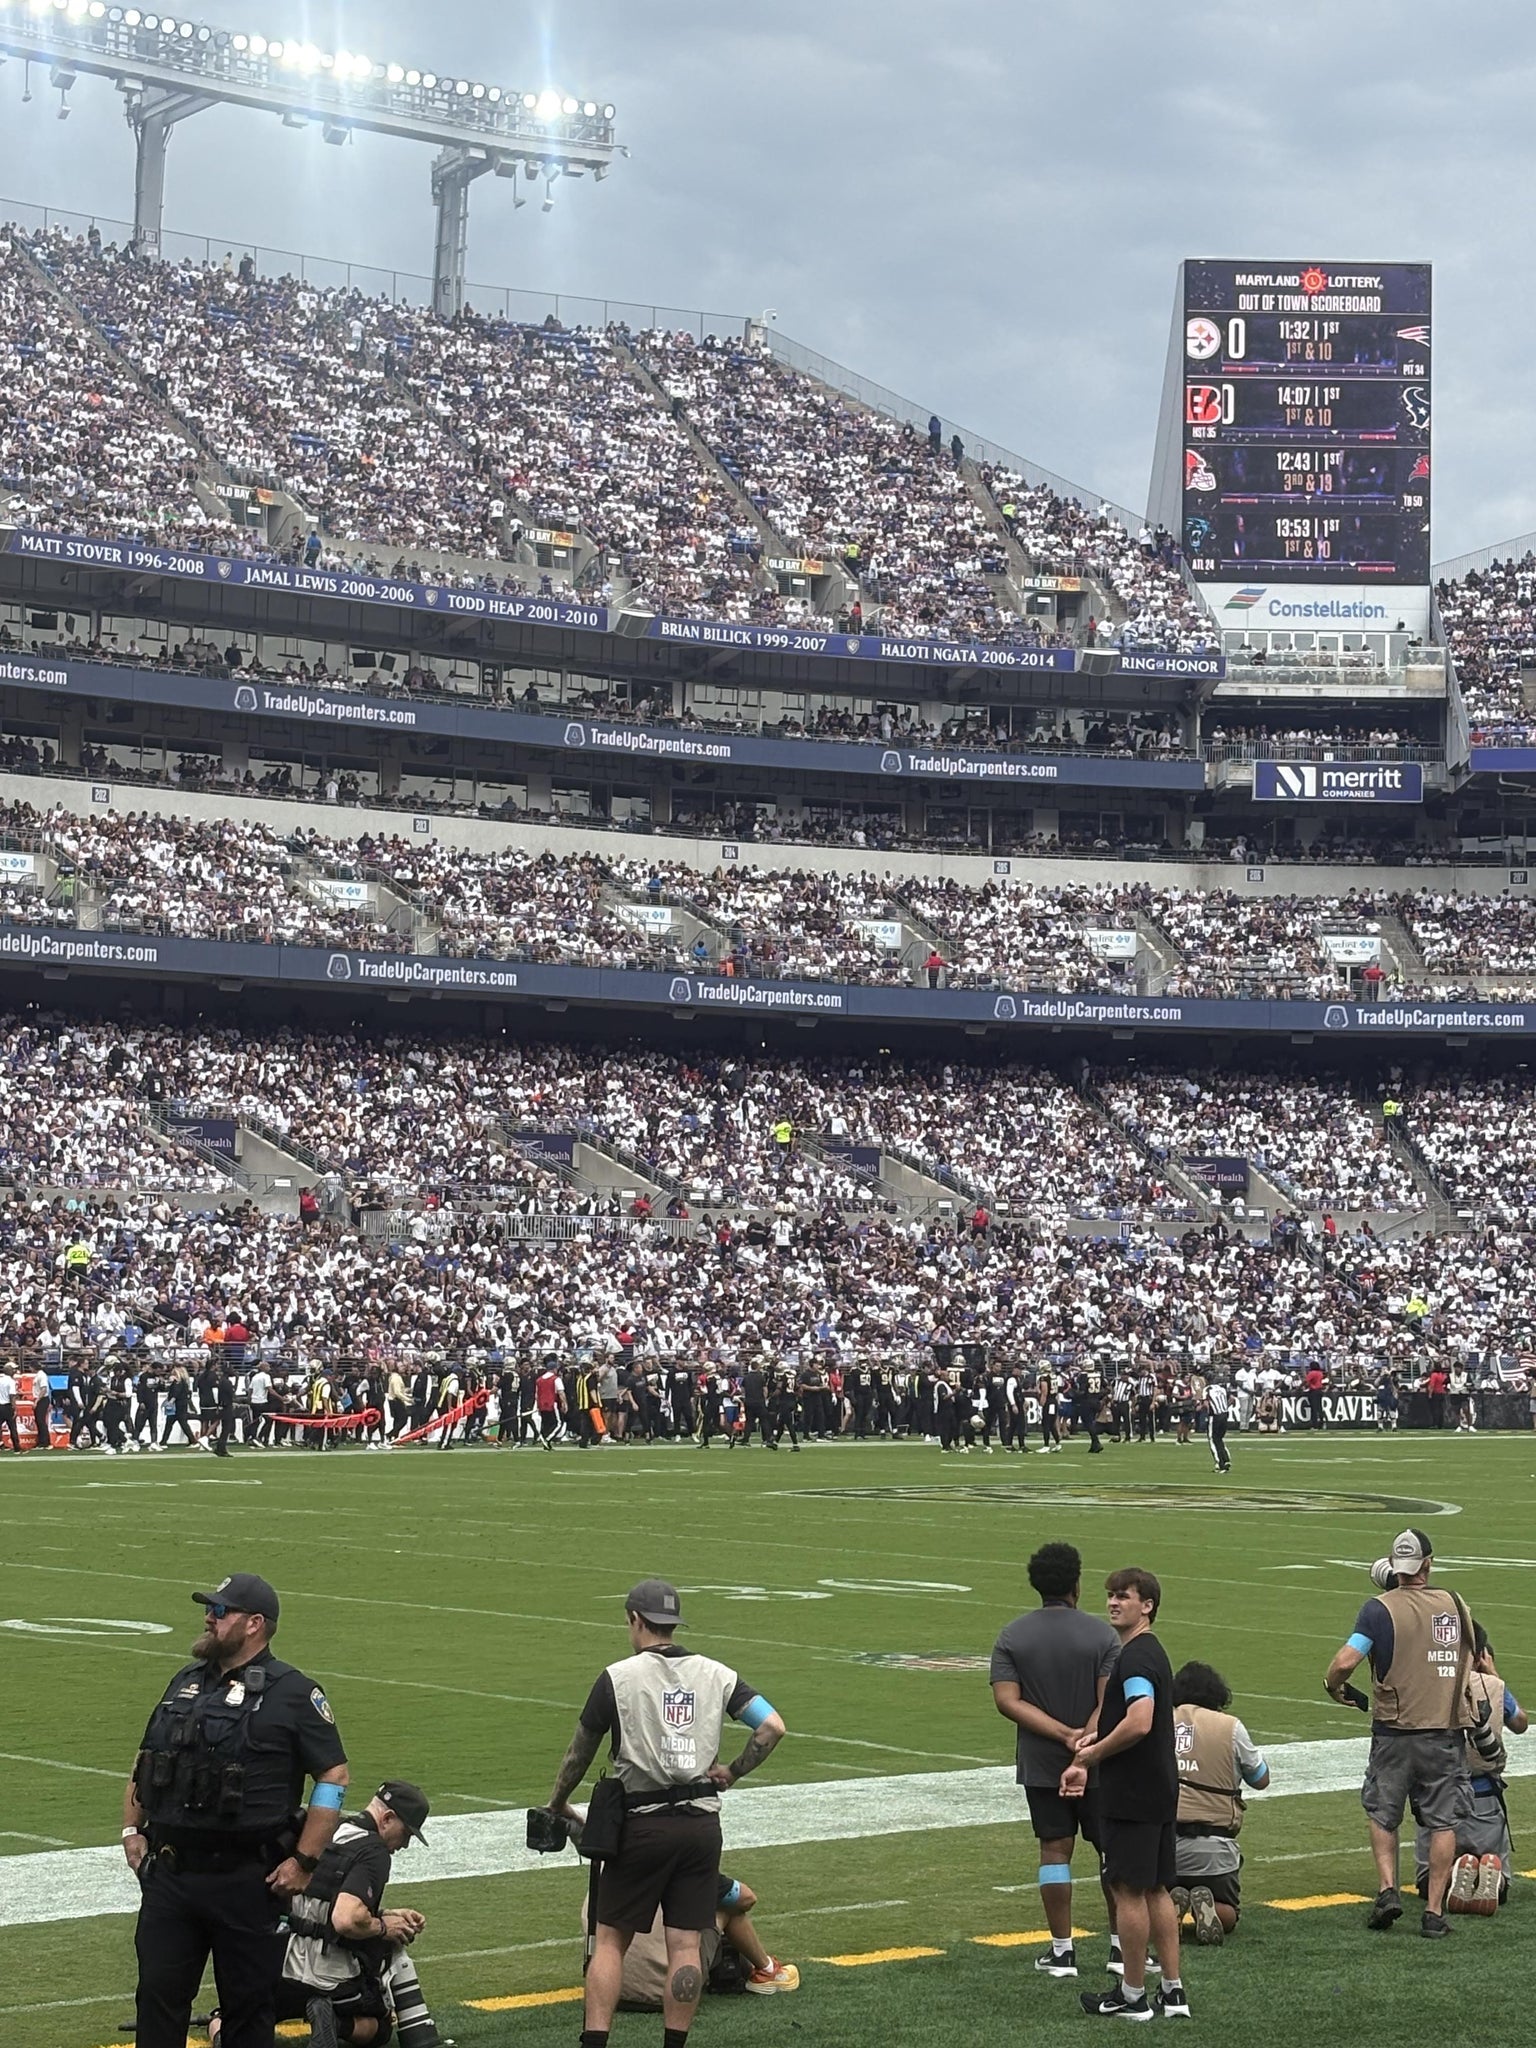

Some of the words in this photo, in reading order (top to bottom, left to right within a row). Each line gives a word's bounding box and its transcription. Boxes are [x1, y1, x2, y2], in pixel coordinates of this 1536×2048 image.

[1235, 274, 1300, 287] MARYLAND
[1328, 276, 1381, 288] LOTTERY
[1239, 294, 1260, 310] OUT
[1262, 294, 1275, 311] OF
[1278, 295, 1309, 311] TOWN
[1311, 296, 1381, 312] SCOREBOARD
[1228, 318, 1246, 359] 0
[1279, 320, 1310, 339] 11:32
[1322, 321, 1340, 340] 1ST
[1286, 342, 1301, 360] 1ST
[1305, 342, 1315, 360] &
[1318, 342, 1332, 360] 10
[1415, 364, 1424, 376] 34
[1278, 386, 1310, 405] 14:07
[1323, 387, 1340, 405] 1ST
[1285, 407, 1301, 426] 1ST
[1304, 408, 1315, 426] &
[1318, 408, 1332, 426] 10
[1277, 452, 1310, 470] 12:43
[1323, 452, 1340, 471] 1ST
[1306, 473, 1315, 492] &
[234, 488, 250, 500] BAY
[1276, 518, 1310, 537] 13:53
[1323, 519, 1340, 538] 1ST
[21, 535, 62, 553] MATT
[66, 541, 122, 563] STOVER
[127, 548, 205, 575] 1996-2008
[1285, 540, 1300, 558] 1ST
[1304, 540, 1314, 558] &
[1317, 540, 1330, 558] 10
[768, 558, 785, 570] OLD
[785, 560, 801, 570] BAY
[1205, 558, 1215, 570] 24
[244, 567, 291, 586] JAMAL
[295, 573, 337, 592] LEWIS
[340, 579, 415, 603] 2000-2006
[1024, 577, 1040, 588] OLD
[1041, 579, 1057, 588] BAY
[448, 593, 486, 612] TODD
[489, 599, 524, 616] HEAP
[527, 602, 598, 627] 2001-2010
[1268, 600, 1387, 619] Constellation
[661, 621, 700, 640] BRIAN
[703, 628, 752, 645] BILLICK
[756, 632, 827, 651] 1999-2007
[881, 643, 929, 661] HALOTI
[933, 648, 977, 663] NGATA
[981, 650, 1055, 667] 2006-2014
[1121, 656, 1155, 671] RING
[1165, 658, 1219, 673] HONOR
[263, 691, 416, 725] TradeUpCarpenters.com
[591, 728, 731, 758] TradeUpCarpenters.com
[908, 755, 1058, 778] TradeUpCarpenters.com
[1322, 767, 1402, 789] merritt
[1322, 790, 1376, 798] COMPANIES
[0, 932, 158, 963] deUpCarpenters.com
[358, 958, 517, 987] TradeUpCarpenters.com
[697, 982, 842, 1008] TradeUpCarpenters.com
[1022, 1000, 1182, 1020] TradeUpCarpenters.com
[1356, 1008, 1525, 1028] TradeUpCarpenters.com
[1322, 1395, 1379, 1422] RAVE
[1434, 1626, 1456, 1641] NFL
[1427, 1651, 1458, 1662] MEDI
[1436, 1666, 1456, 1677] 128
[665, 1705, 692, 1724] NFL
[660, 1736, 696, 1752] MEDIA
[1175, 1736, 1191, 1750] FL
[1178, 1759, 1199, 1771] DIA
